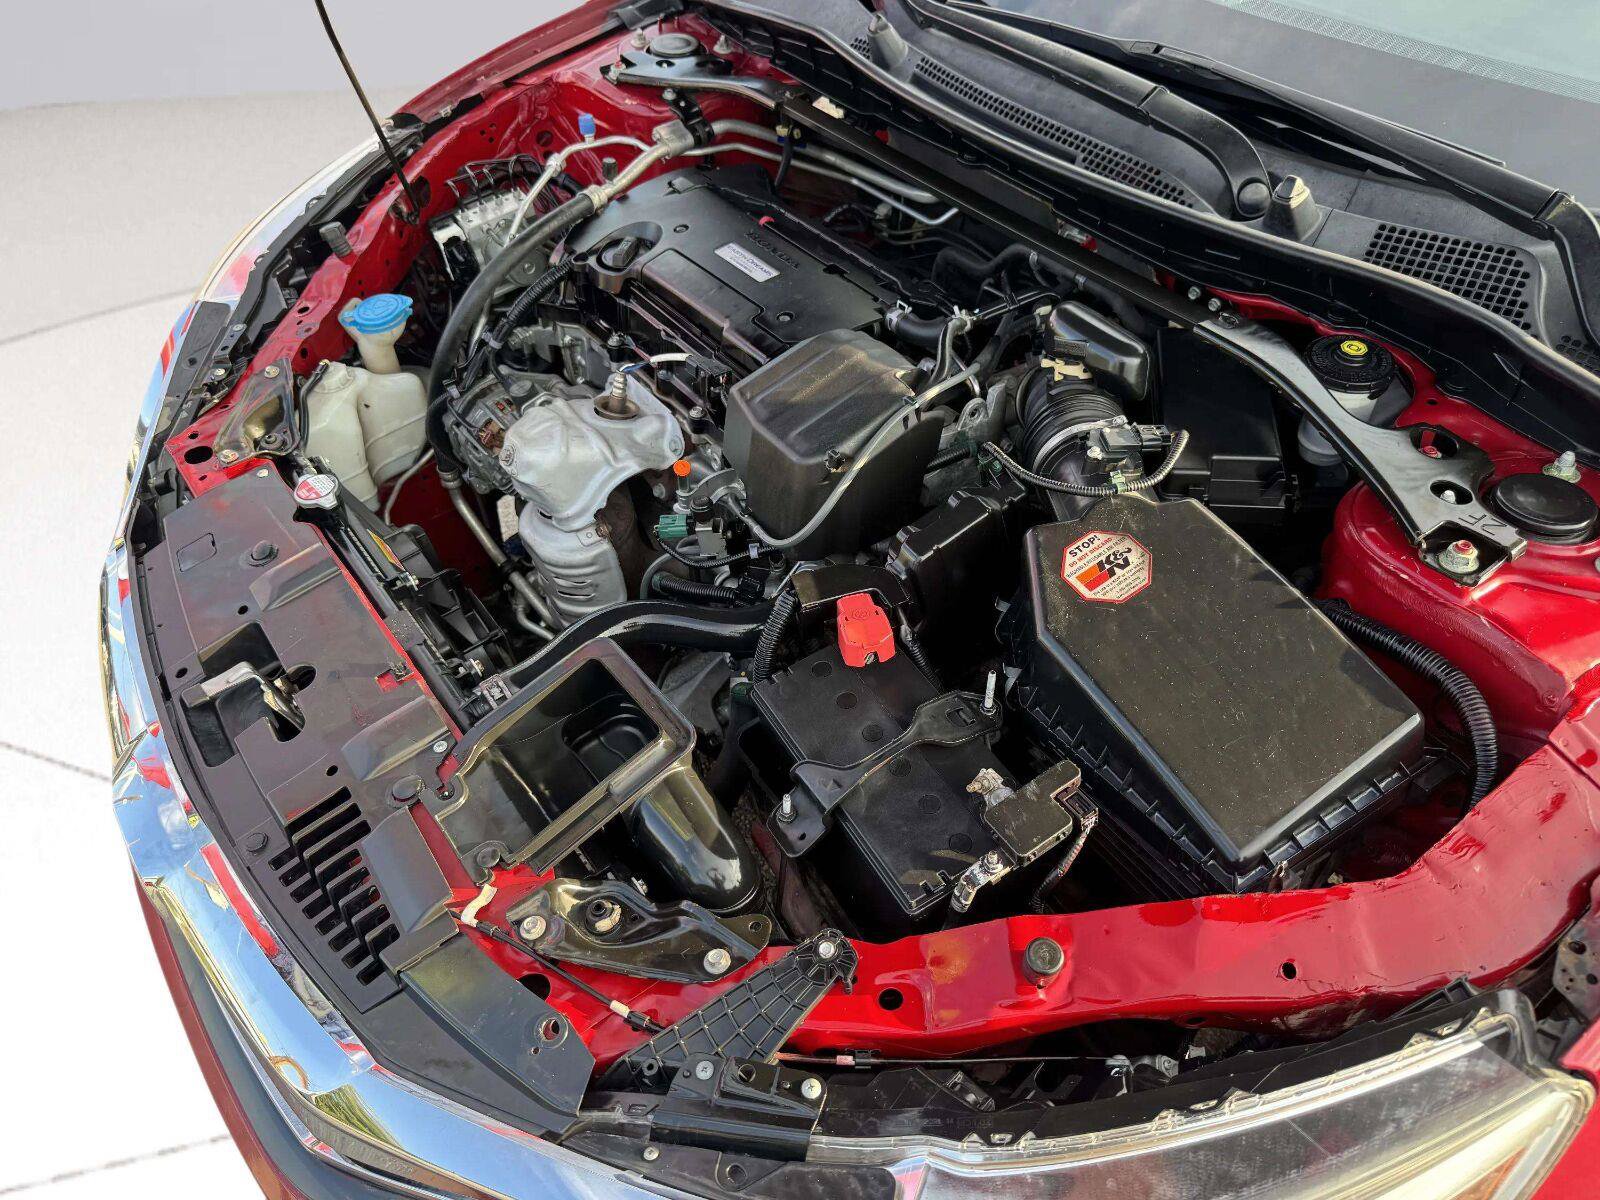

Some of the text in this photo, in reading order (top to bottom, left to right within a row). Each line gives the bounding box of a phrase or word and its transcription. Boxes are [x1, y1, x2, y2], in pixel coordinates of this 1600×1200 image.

[747, 258, 774, 277] DREAMS
[1068, 534, 1101, 558] STOP!
[1068, 537, 1113, 568] DO NOT DISCARD
